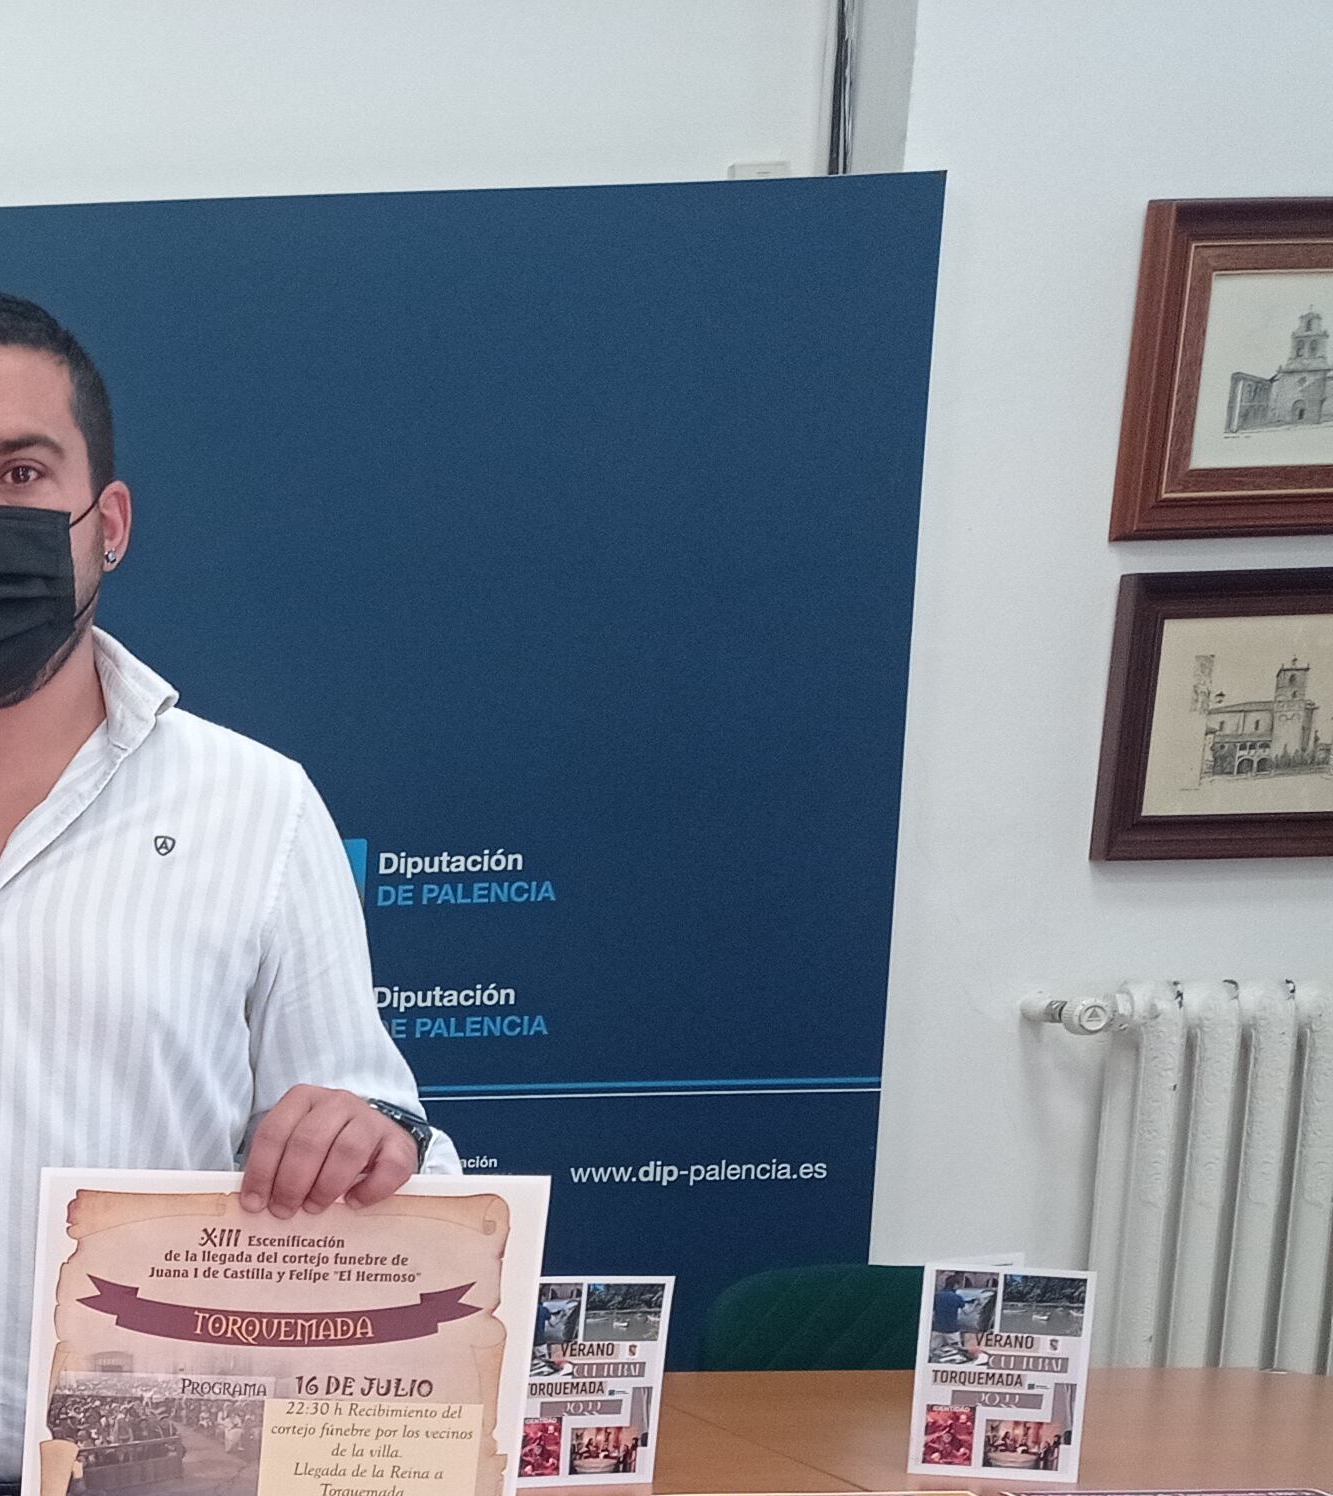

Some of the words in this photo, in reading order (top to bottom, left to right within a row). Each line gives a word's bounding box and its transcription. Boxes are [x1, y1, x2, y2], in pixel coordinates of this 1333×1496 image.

[379, 848, 523, 877] Diputación
[377, 885, 414, 906] DE
[422, 880, 556, 904] PALENCIA
[373, 984, 515, 1012] Diputación
[415, 1015, 548, 1038] PALENCIA
[570, 1158, 827, 1186] www.dip-palencia.es
[198, 1227, 241, 1248] XIII
[247, 1235, 344, 1248] Escenificación
[164, 1249, 180, 1262] de
[184, 1249, 197, 1262] la
[201, 1250, 252, 1265] llegada
[256, 1251, 278, 1263] del
[282, 1252, 329, 1267] cortejo
[334, 1252, 387, 1266] funebre
[391, 1253, 408, 1266] de
[148, 1266, 189, 1278] Juana
[193, 1267, 198, 1278] I
[202, 1266, 219, 1279] de
[223, 1267, 273, 1280] Castilla
[276, 1271, 286, 1283] y
[288, 1268, 330, 1283] Felipe
[333, 1269, 351, 1281] "El
[355, 1270, 421, 1283] Hermoso"
[194, 1311, 374, 1343] TORQUEMADA
[561, 1343, 615, 1357] VERANO
[976, 1334, 1034, 1349] VERANO
[295, 1375, 319, 1395] 16
[325, 1375, 355, 1396] DE
[360, 1376, 433, 1397] JULIO
[932, 1370, 1023, 1387] TORQUEMADA
[285, 1401, 330, 1415] 22:30
[334, 1401, 342, 1416] h
[347, 1402, 438, 1418] Recibimiento
[441, 1405, 462, 1419] del
